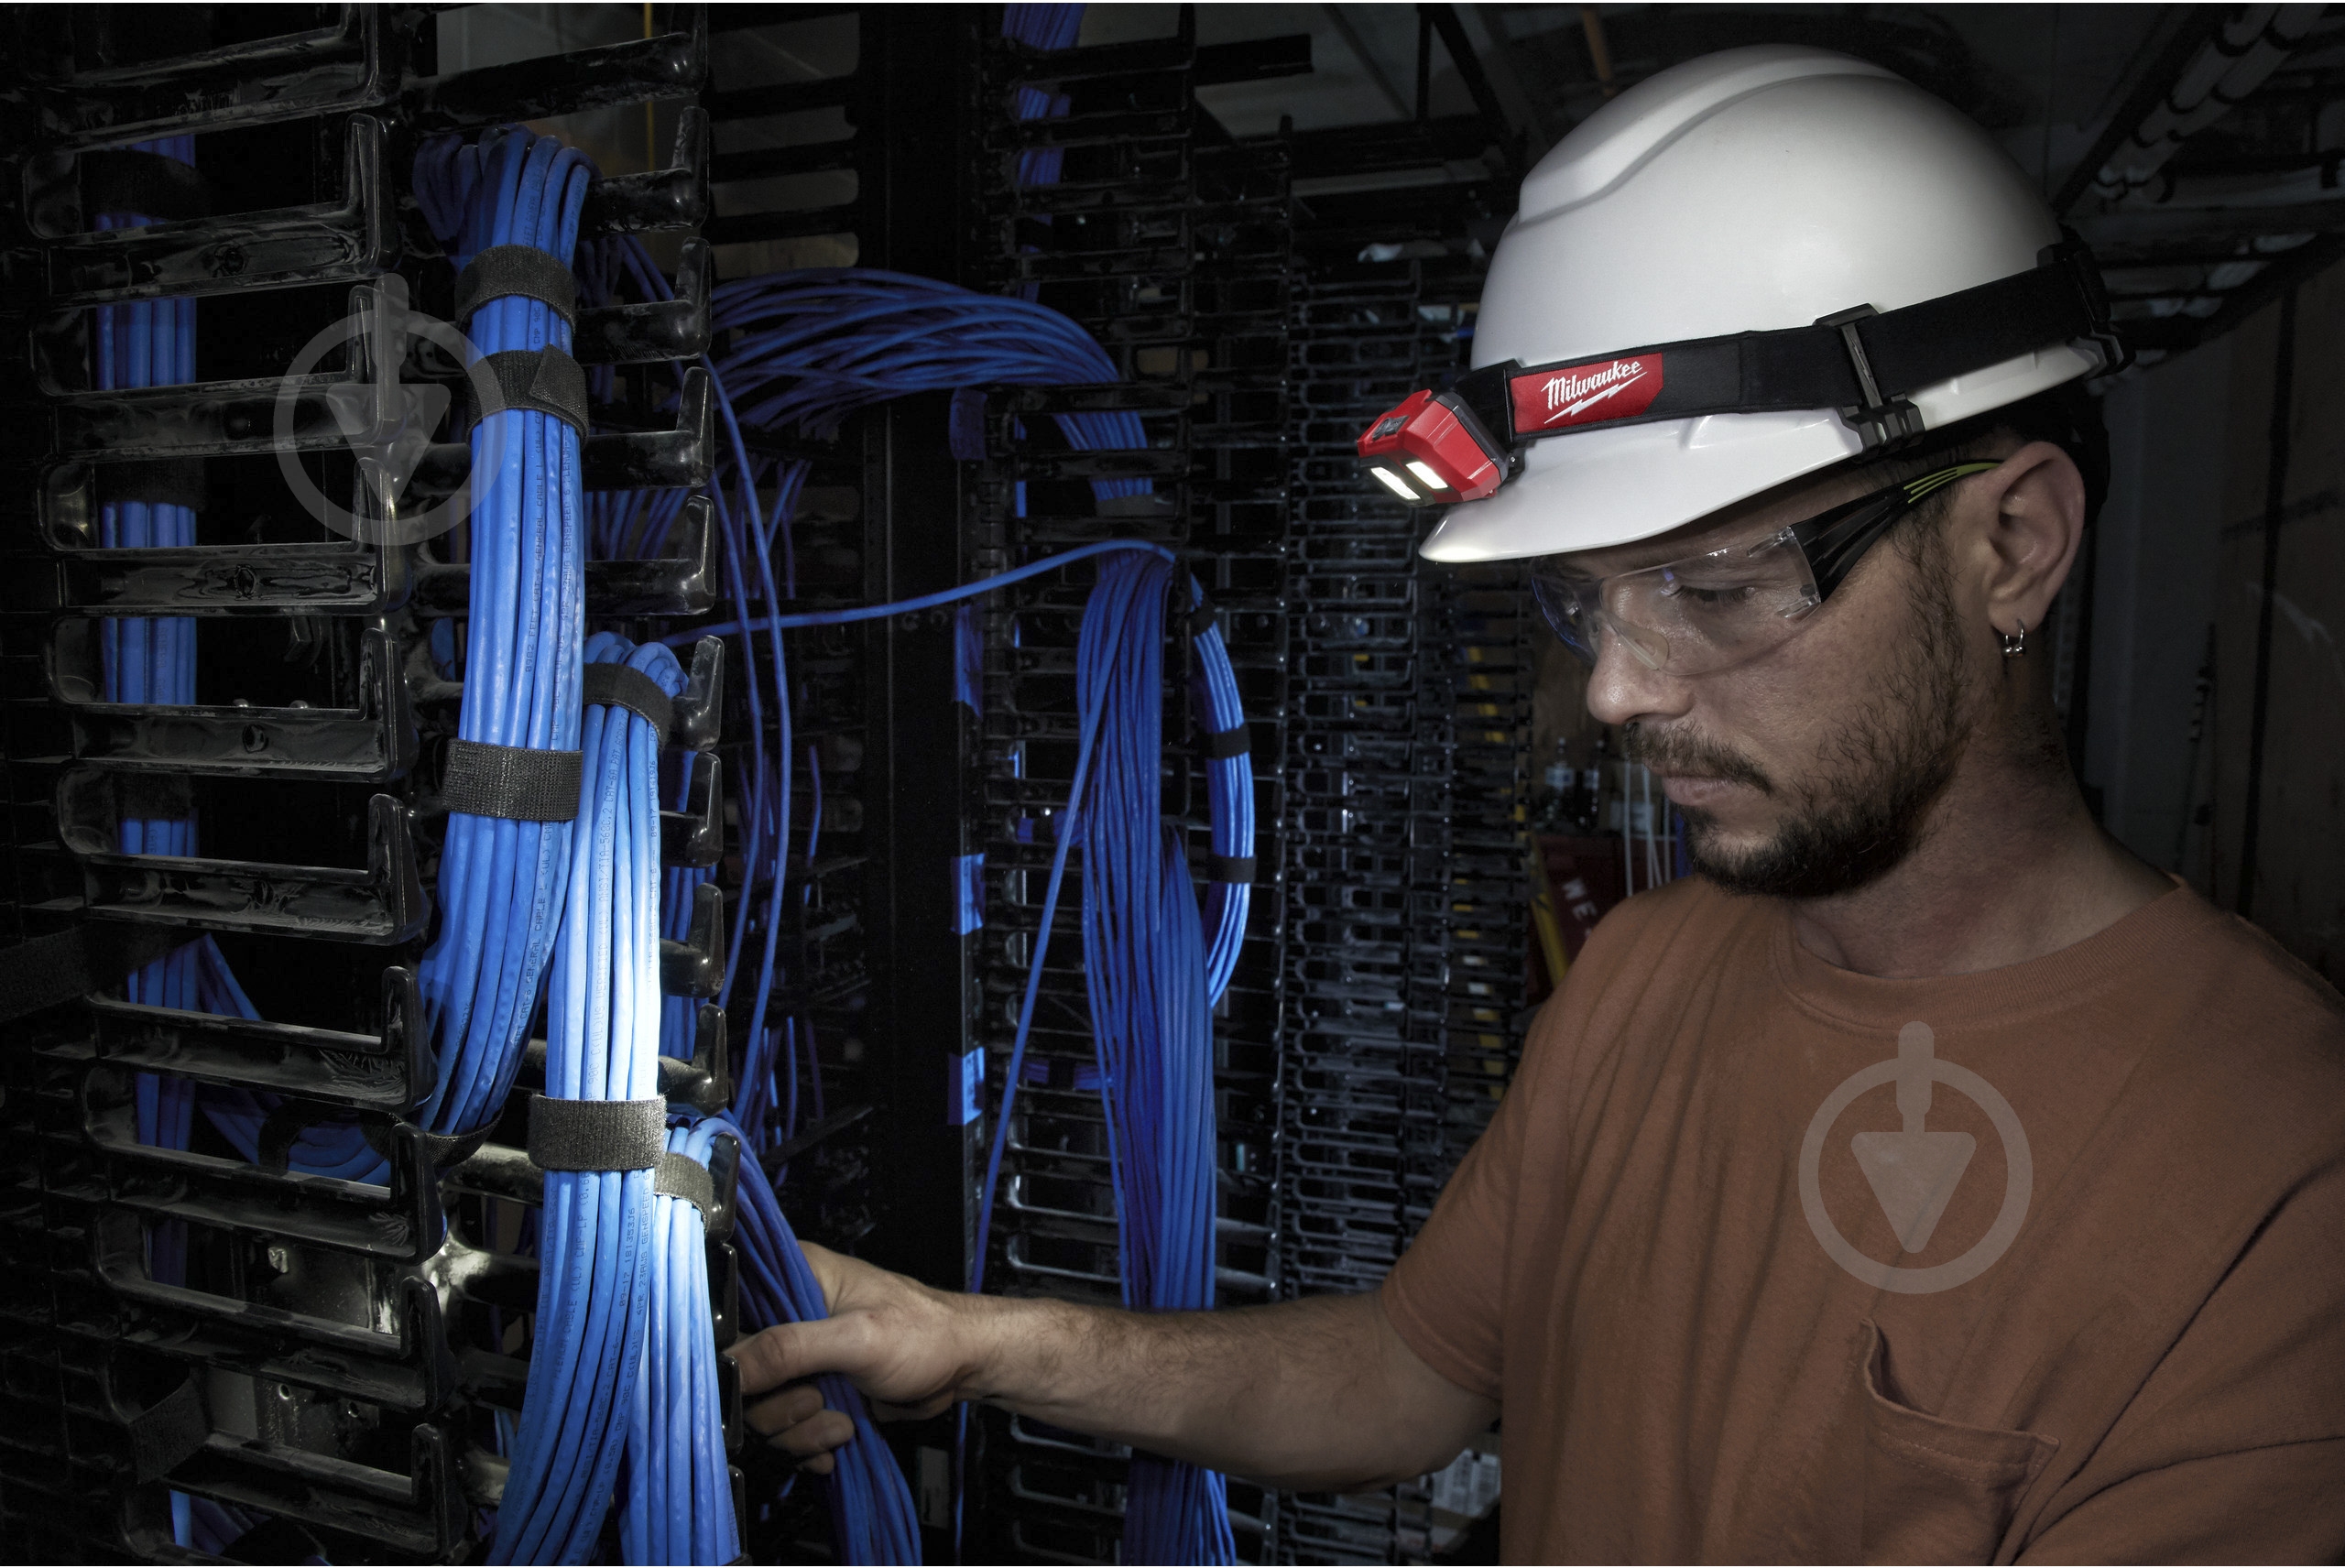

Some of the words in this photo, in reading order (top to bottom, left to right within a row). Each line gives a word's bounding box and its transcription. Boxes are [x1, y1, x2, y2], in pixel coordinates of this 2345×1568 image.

[1541, 361, 1642, 410] Milwaukee
[529, 609, 538, 637] FEET
[523, 938, 540, 984] GENERAL
[532, 897, 546, 931] CABLE
[540, 848, 551, 876] (UL)
[641, 1187, 650, 1245] GENSPEED
[574, 1214, 587, 1258] CMP-LP
[624, 1207, 636, 1264] 1B1353J6
[569, 1266, 583, 1291] (UL)
[638, 1250, 649, 1288] 23AWG
[618, 1271, 631, 1307] 09-17
[637, 1294, 646, 1315] 4PR
[615, 1412, 625, 1432] CMP
